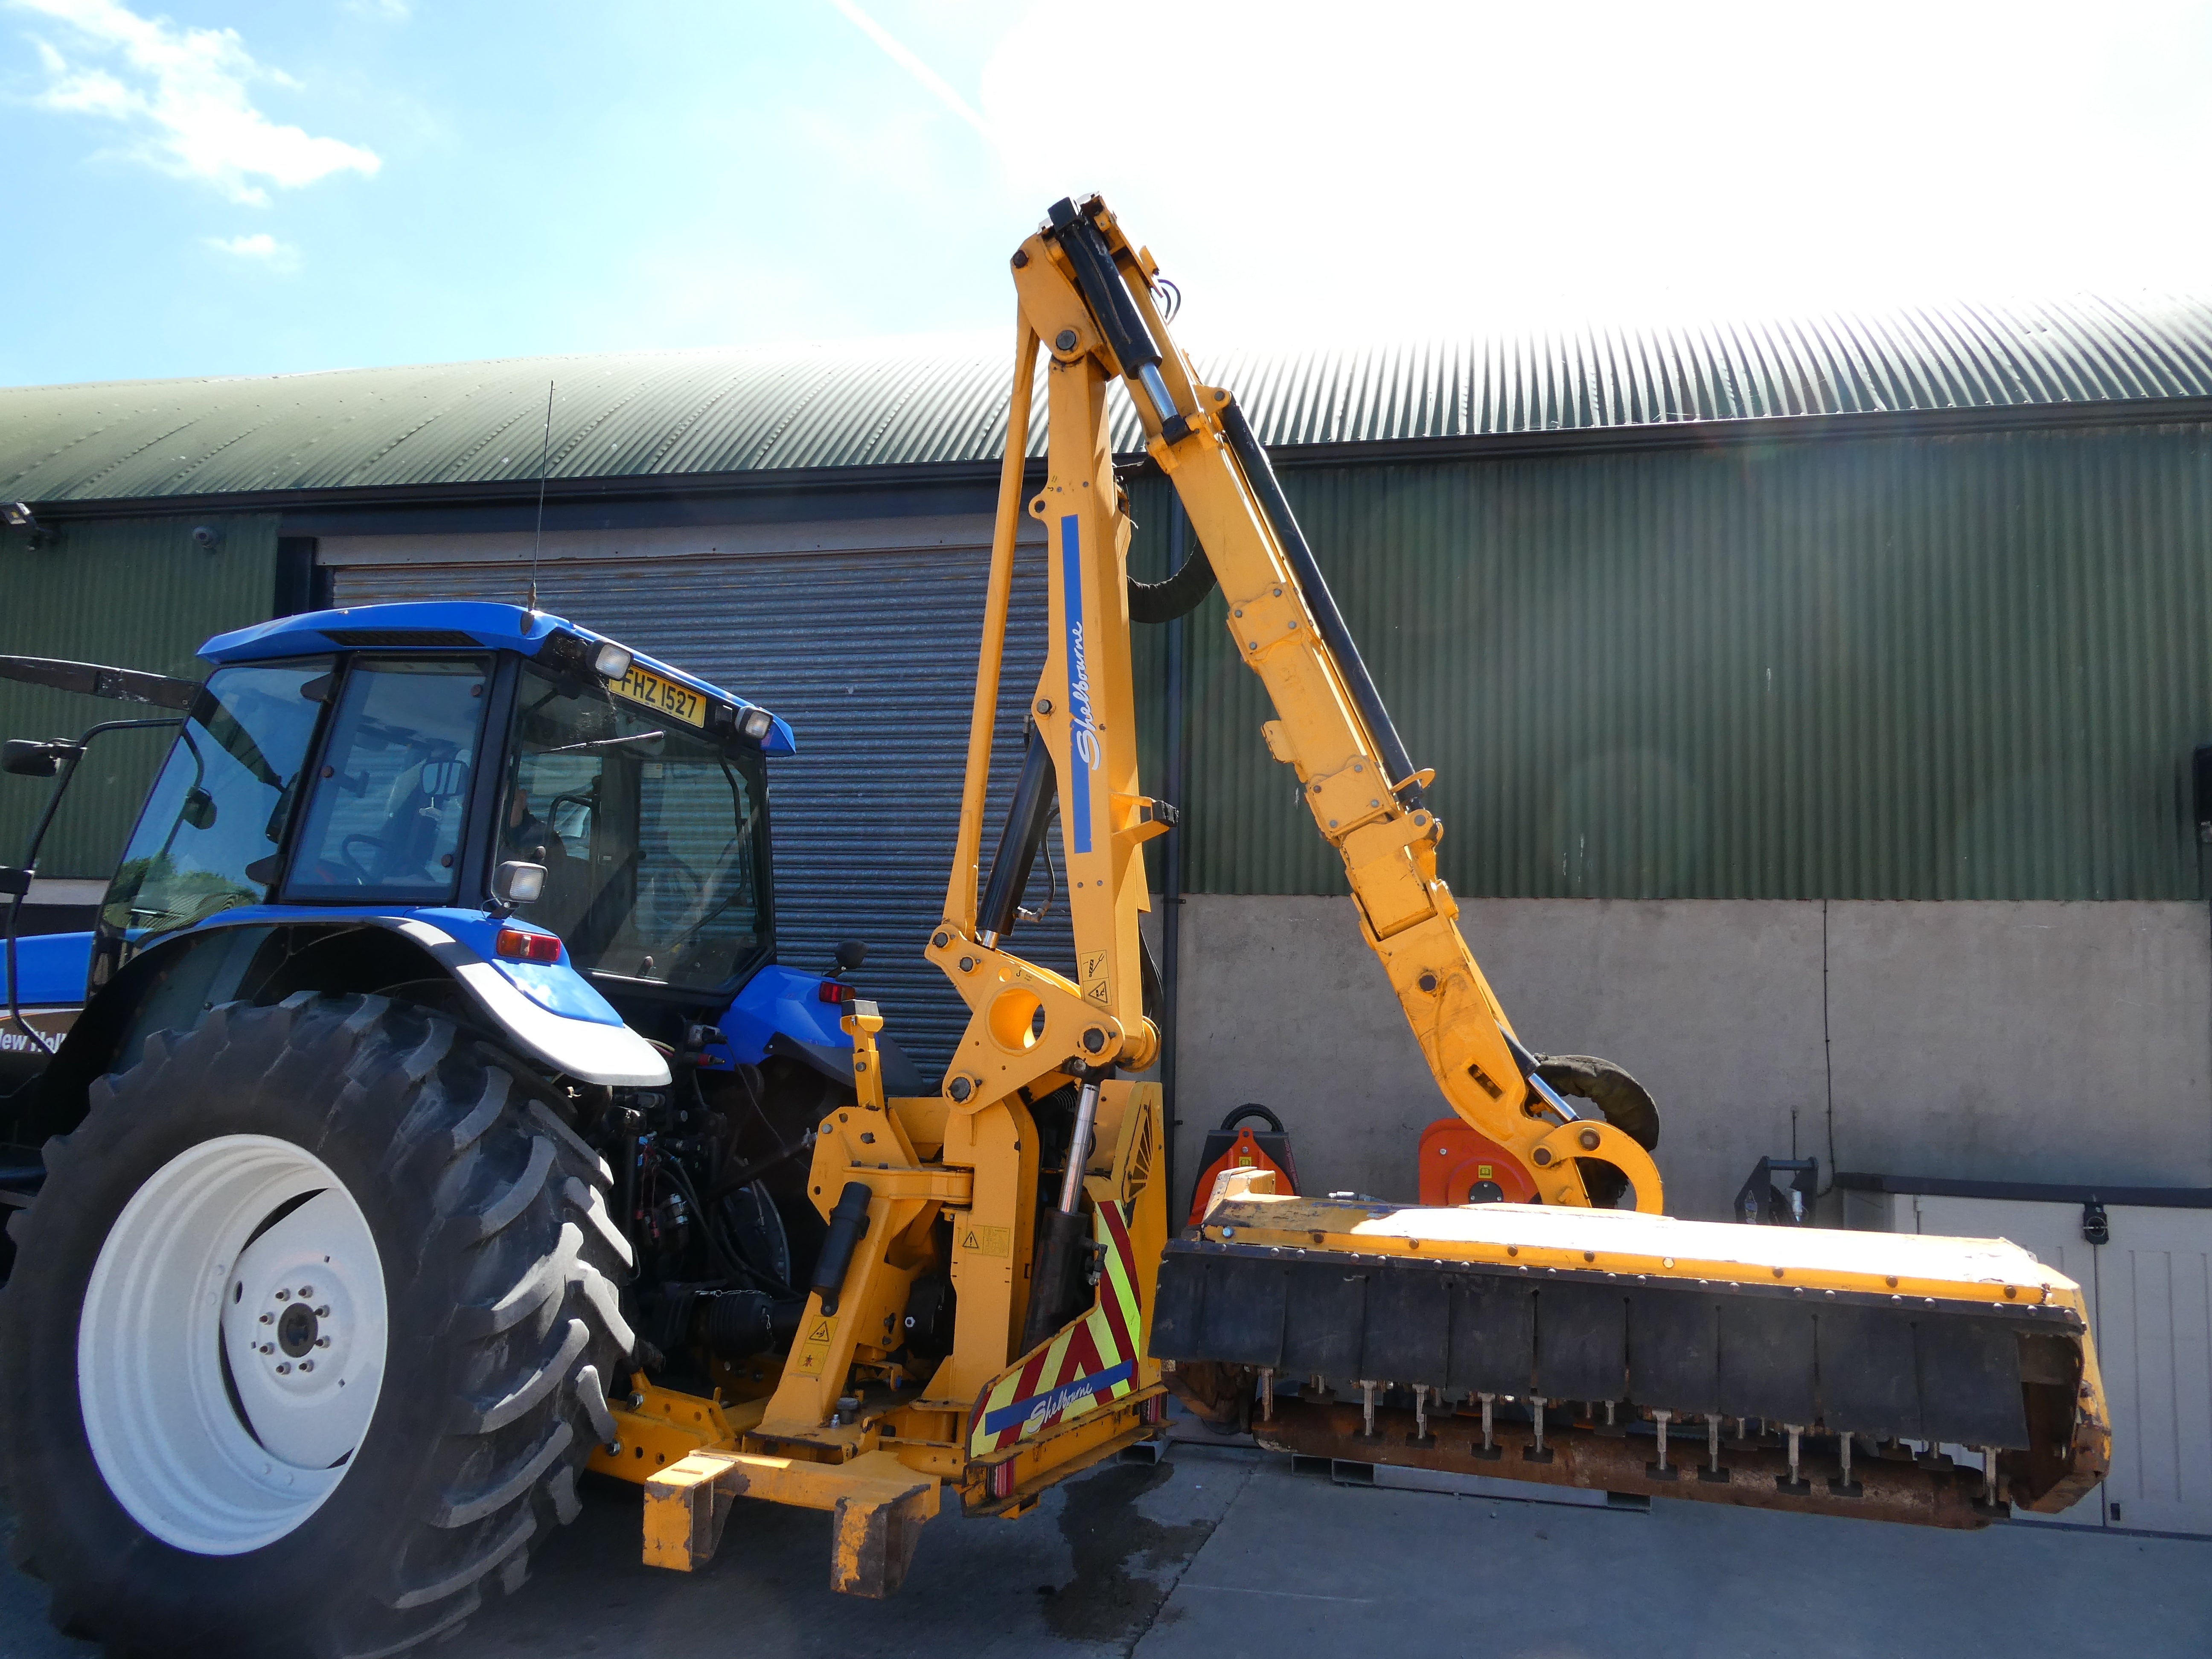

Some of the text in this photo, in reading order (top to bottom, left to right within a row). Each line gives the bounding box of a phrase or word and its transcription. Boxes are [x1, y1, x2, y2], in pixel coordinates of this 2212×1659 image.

[660, 682, 697, 718] 1527
[1072, 621, 1100, 770] Shelbourne
[1027, 1382, 1092, 1433] Shelbourne
